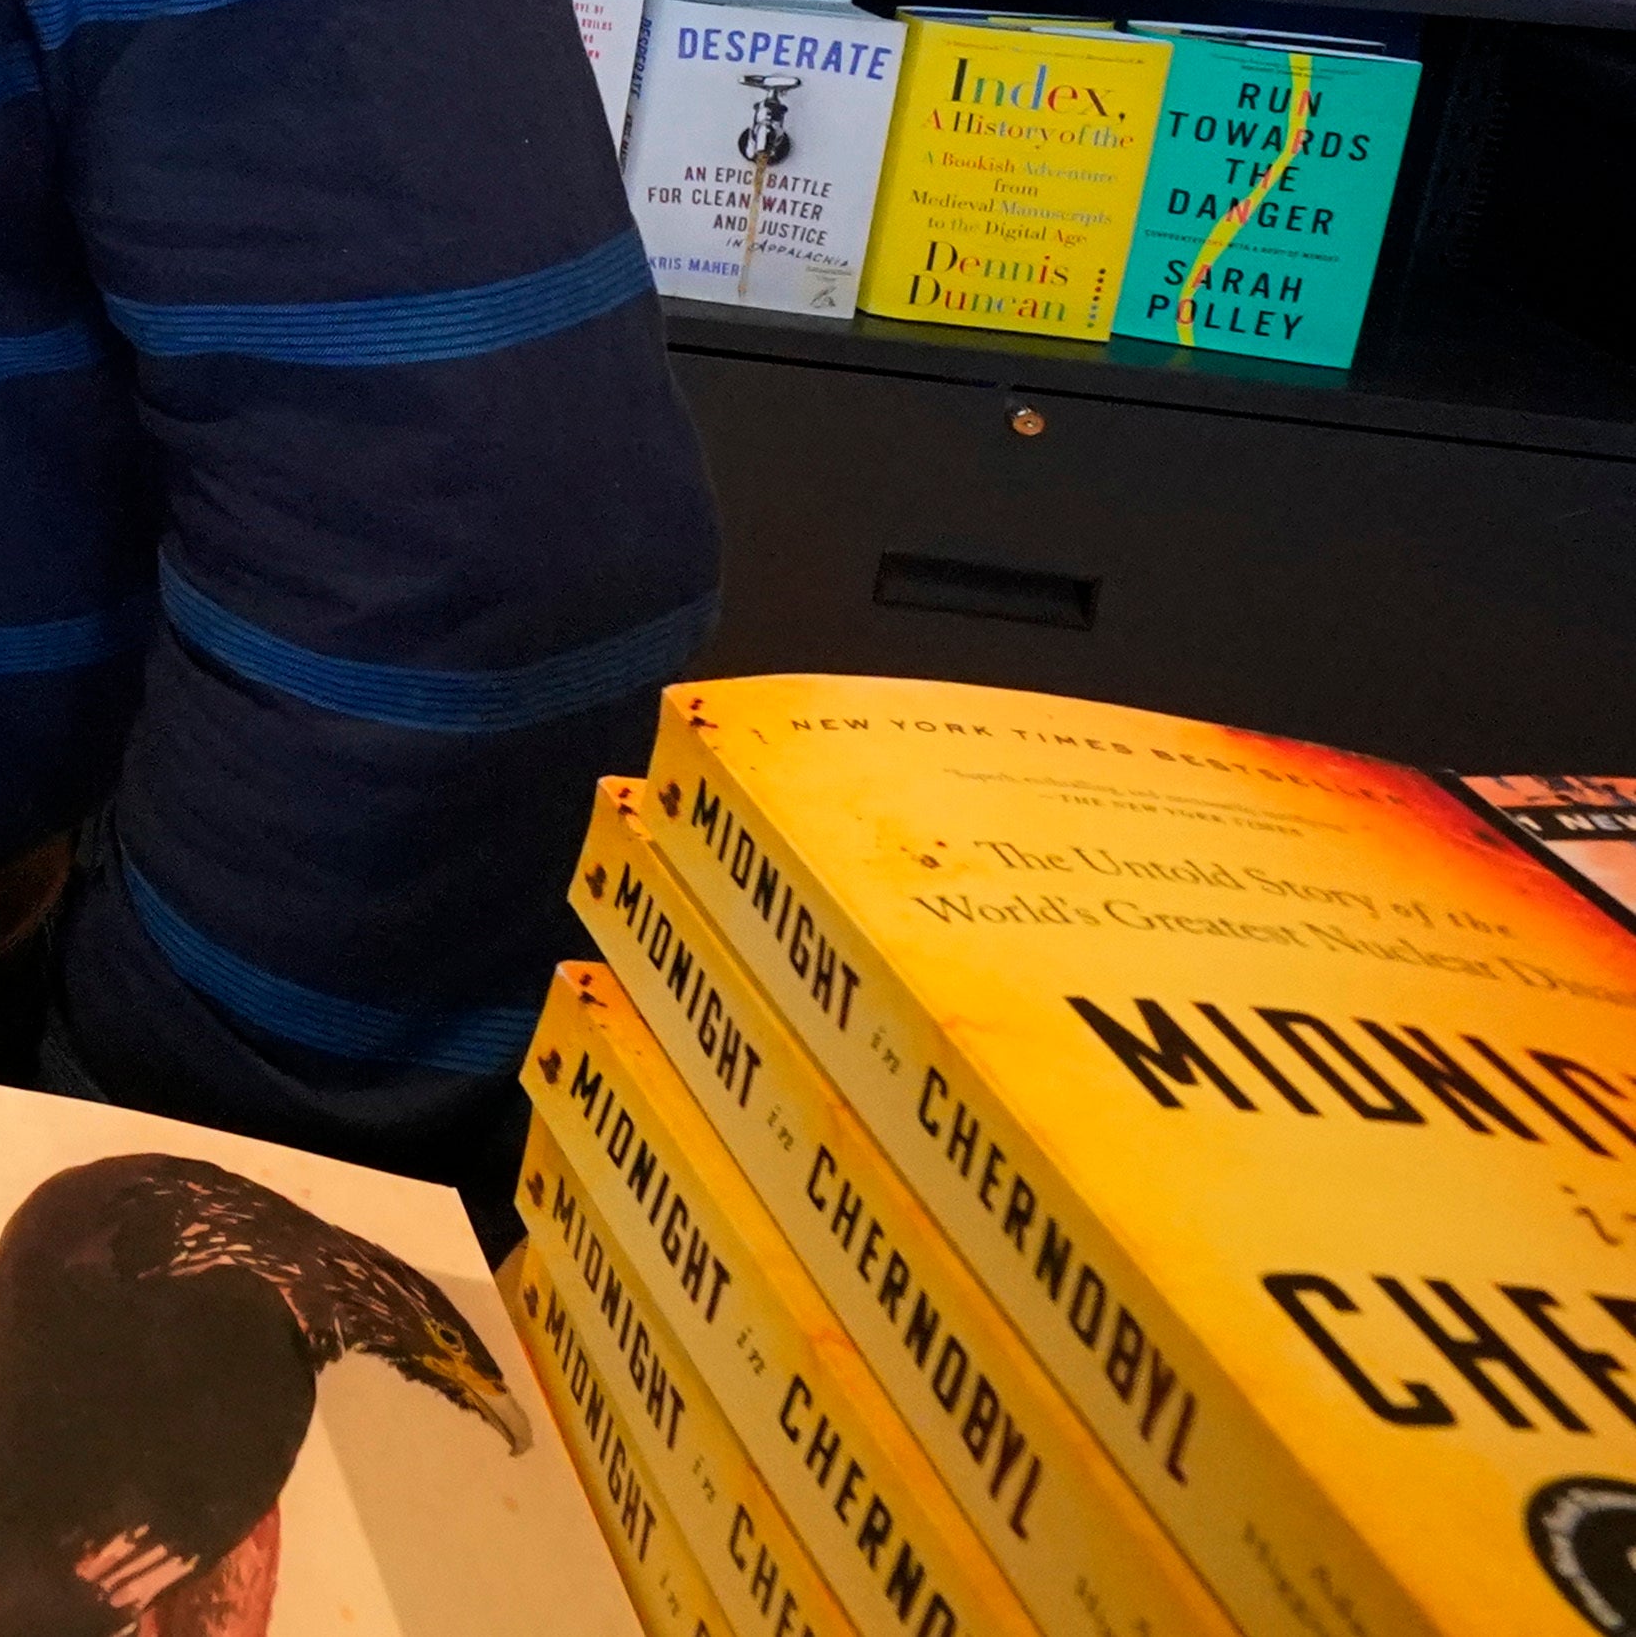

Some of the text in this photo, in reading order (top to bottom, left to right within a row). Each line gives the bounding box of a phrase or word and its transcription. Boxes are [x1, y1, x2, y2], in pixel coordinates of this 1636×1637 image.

[678, 26, 893, 82] DESPERATE
[949, 56, 1128, 124] Index,
[951, 111, 1053, 150] History
[1168, 110, 1371, 163] TOWARDS
[761, 195, 824, 221] WATER
[765, 173, 833, 199] BATTLE
[910, 188, 996, 214] Medieval
[758, 218, 828, 247] JUSTICE
[984, 216, 1048, 244] Digital
[1168, 186, 1336, 236] DANGER
[749, 238, 850, 268] APPALACHIA
[925, 239, 1069, 287] Dennis
[907, 273, 1067, 322] Duncan
[1146, 293, 1305, 342] POLLEY
[889, 718, 1134, 757] YORK TIMES
[1085, 846, 1242, 894] Untold
[1105, 897, 1306, 950] Greatest
[688, 775, 1205, 1489] MIDNIGHT CHERNOBYL
[611, 859, 1044, 1543] MIDNIGHT CHERNOBYL
